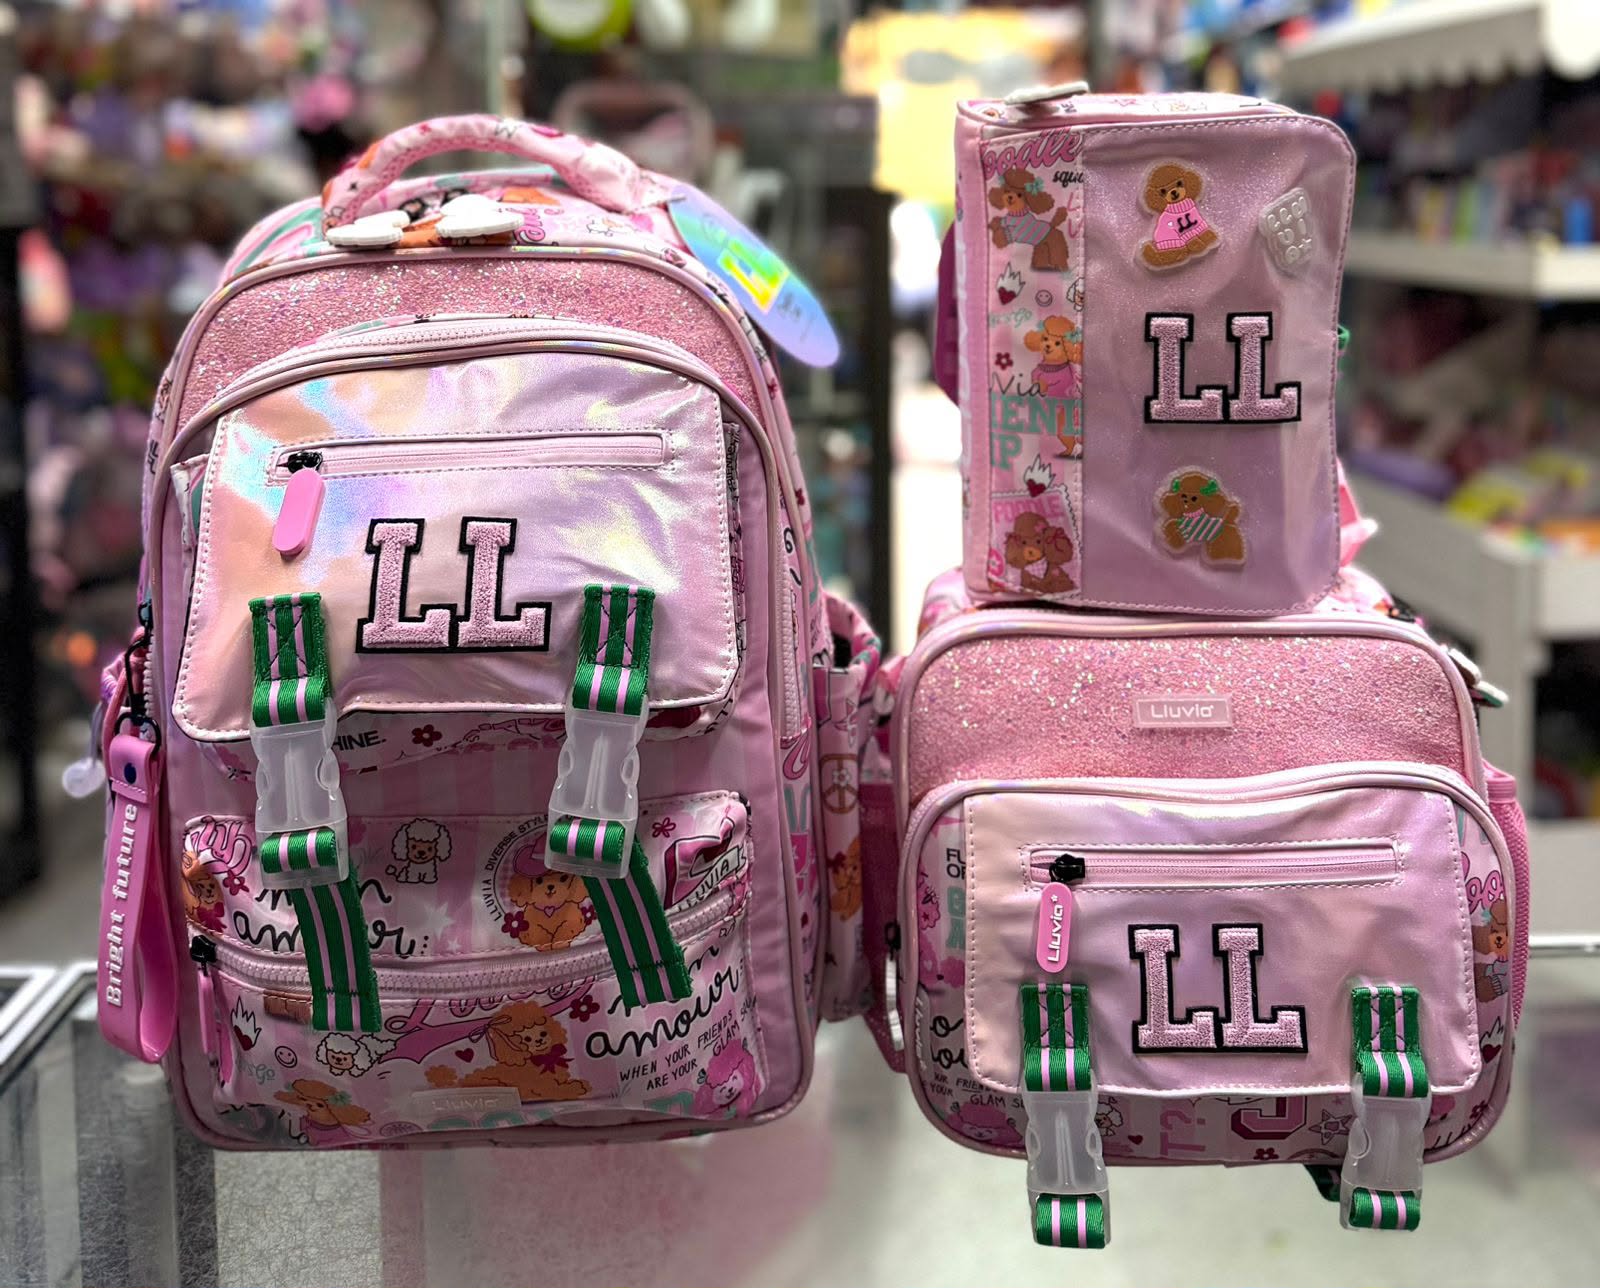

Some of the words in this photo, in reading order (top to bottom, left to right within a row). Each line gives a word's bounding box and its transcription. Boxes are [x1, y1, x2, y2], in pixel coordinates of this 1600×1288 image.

[1145, 311, 1301, 424] LL
[357, 517, 552, 653] LL
[1150, 703, 1214, 718] Lluvia
[113, 803, 138, 900] future
[484, 831, 518, 871] DIVERSE
[106, 910, 127, 1006] Bright
[1047, 903, 1064, 962] Lluvia
[1128, 924, 1307, 1053] LL
[619, 1059, 657, 1082] WHEN
[665, 1044, 692, 1068] YOUR
[697, 1009, 734, 1049] FRIENDS
[646, 1074, 669, 1091] ARE
[671, 1058, 698, 1081] YOUR
[712, 1021, 741, 1056] GLAM
